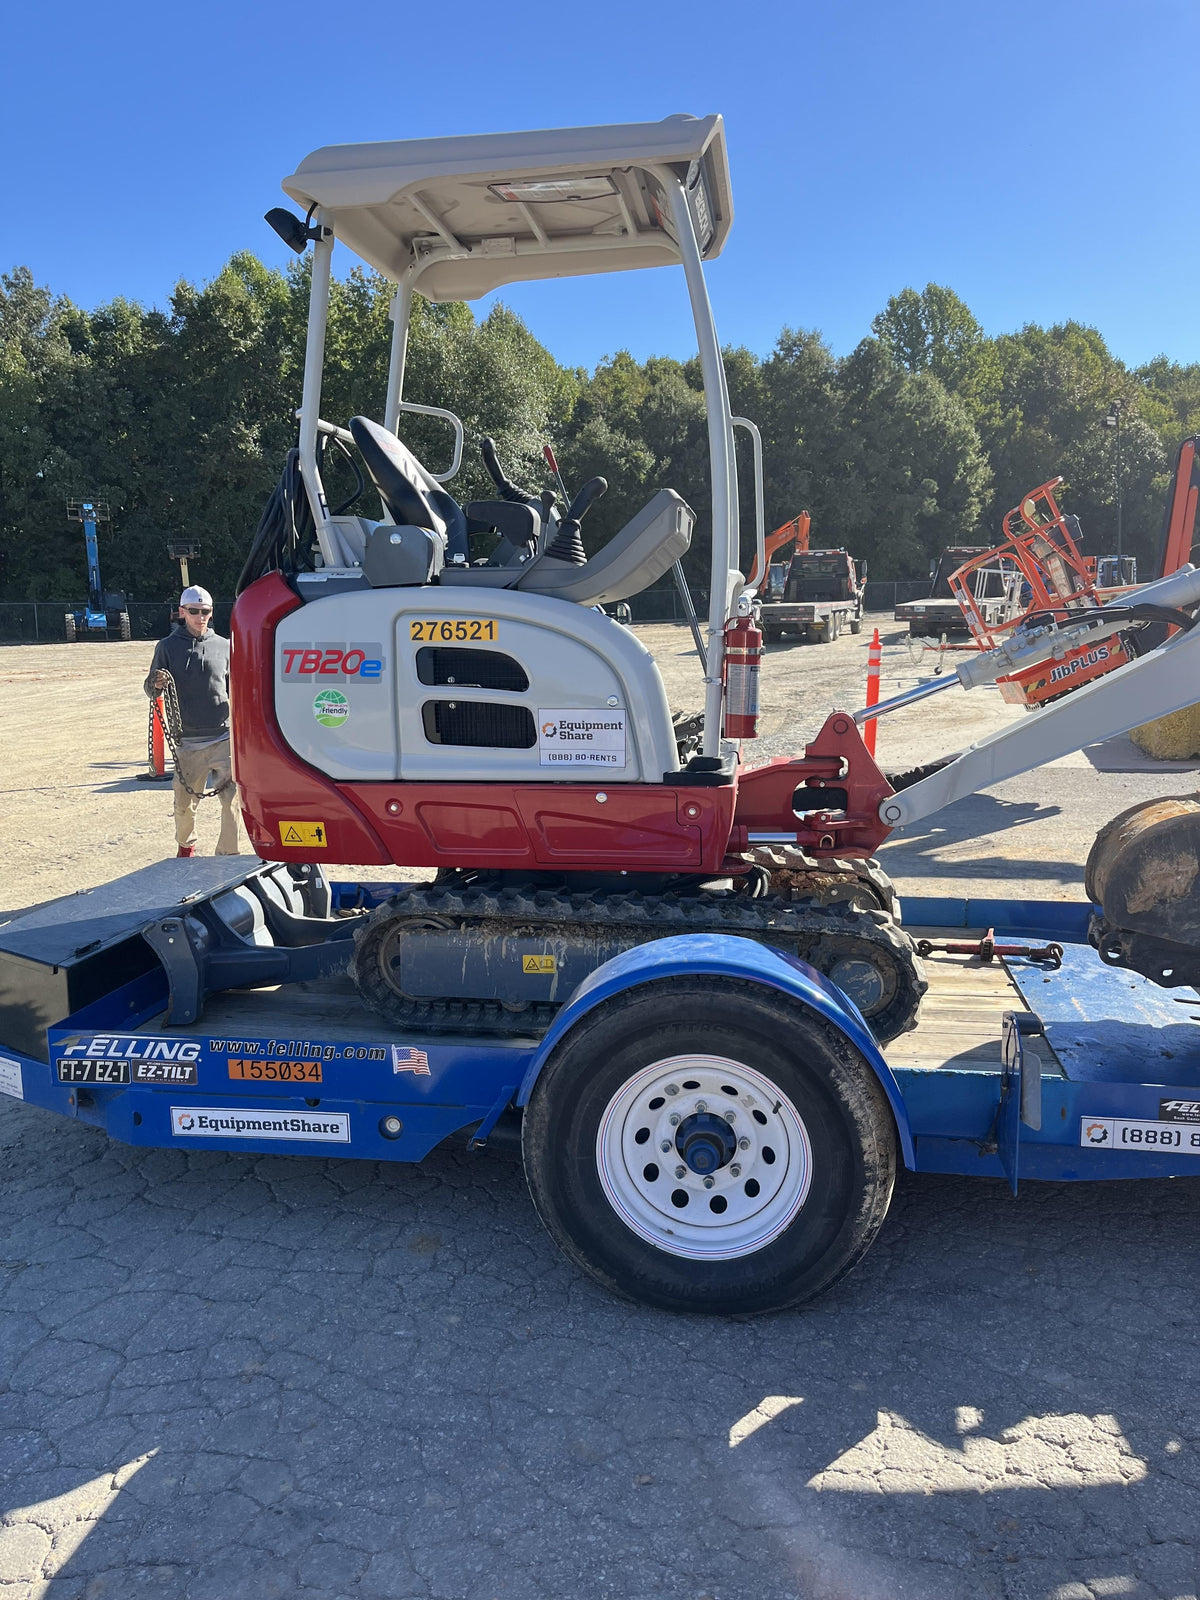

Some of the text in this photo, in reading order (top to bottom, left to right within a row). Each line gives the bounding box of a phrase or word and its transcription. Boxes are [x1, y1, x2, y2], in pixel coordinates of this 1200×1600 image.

[411, 620, 494, 641] 276521
[283, 649, 382, 678] TB20e
[1050, 646, 1110, 684] JibPLUS
[559, 720, 623, 732] Equipment
[559, 731, 593, 741] Share
[548, 753, 617, 762] (888) 80-RENTS
[52, 1034, 201, 1062] FELLING
[209, 1039, 387, 1061] www.felling.com
[137, 1064, 193, 1080] EZ-TILT
[236, 1059, 321, 1082] 155034
[198, 1115, 340, 1134] EquipmentShare
[1121, 1127, 1181, 1147] (888)
